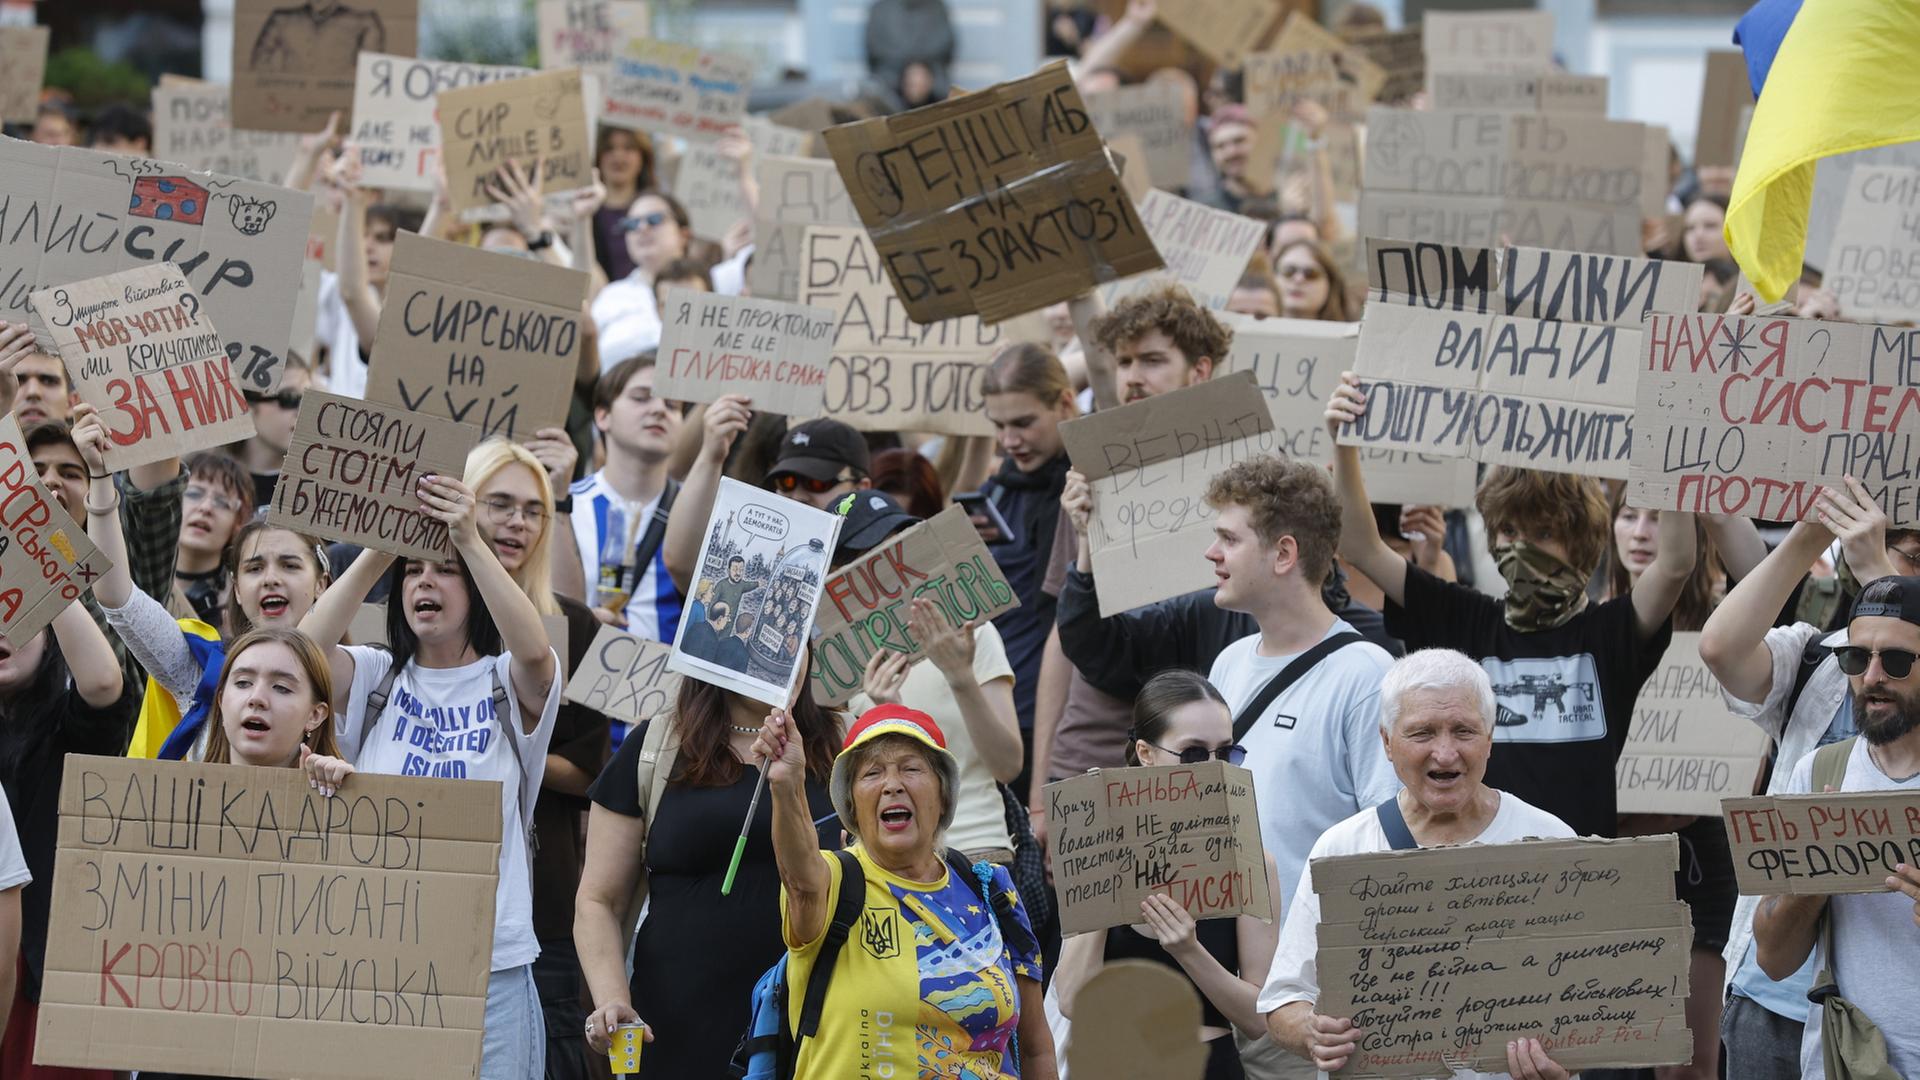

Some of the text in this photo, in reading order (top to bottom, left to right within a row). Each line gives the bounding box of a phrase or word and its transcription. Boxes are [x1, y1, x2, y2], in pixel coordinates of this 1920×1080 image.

[370, 58, 393, 98] Я
[409, 126, 432, 143] НЕ
[454, 101, 511, 140] СИР
[549, 125, 564, 151] В
[1451, 113, 1569, 151] ГЕТЬ
[875, 84, 1089, 204] ГЕНШТАБ
[954, 174, 1025, 227] НА
[808, 234, 883, 288] БА
[1377, 242, 1663, 323] ПОМИЛКИ
[403, 290, 577, 357] СИРСЬКОГО
[674, 302, 692, 326] Я
[701, 305, 729, 329] НЕ
[448, 352, 485, 386] НА
[669, 348, 771, 383] ГЛИБОКА
[1435, 319, 1616, 385] ВЛАДИ
[106, 356, 249, 446] ЗА НИХ
[317, 401, 426, 460] СТОЯЛИ
[1663, 425, 1920, 481] ЩО ПРАЦ
[291, 478, 379, 536] БУДЕМО
[824, 540, 929, 624] FUCK
[392, 715, 491, 754] A DEERTED
[1052, 790, 1095, 827] Кричу
[1730, 808, 1799, 844] ГЕТЬ
[1808, 806, 1893, 841] РУКИ
[1058, 824, 1125, 856] волання
[1136, 814, 1164, 838] НЕ
[1143, 836, 1194, 869] була
[1066, 859, 1179, 907] тепер НАС
[1151, 867, 1254, 914] ТИСЯЧІ
[1350, 872, 1434, 901] Дайте
[1390, 969, 1415, 983] не
[1427, 956, 1506, 977] війна
[1521, 955, 1539, 967] а
[1362, 1029, 1434, 1052] Сестра
